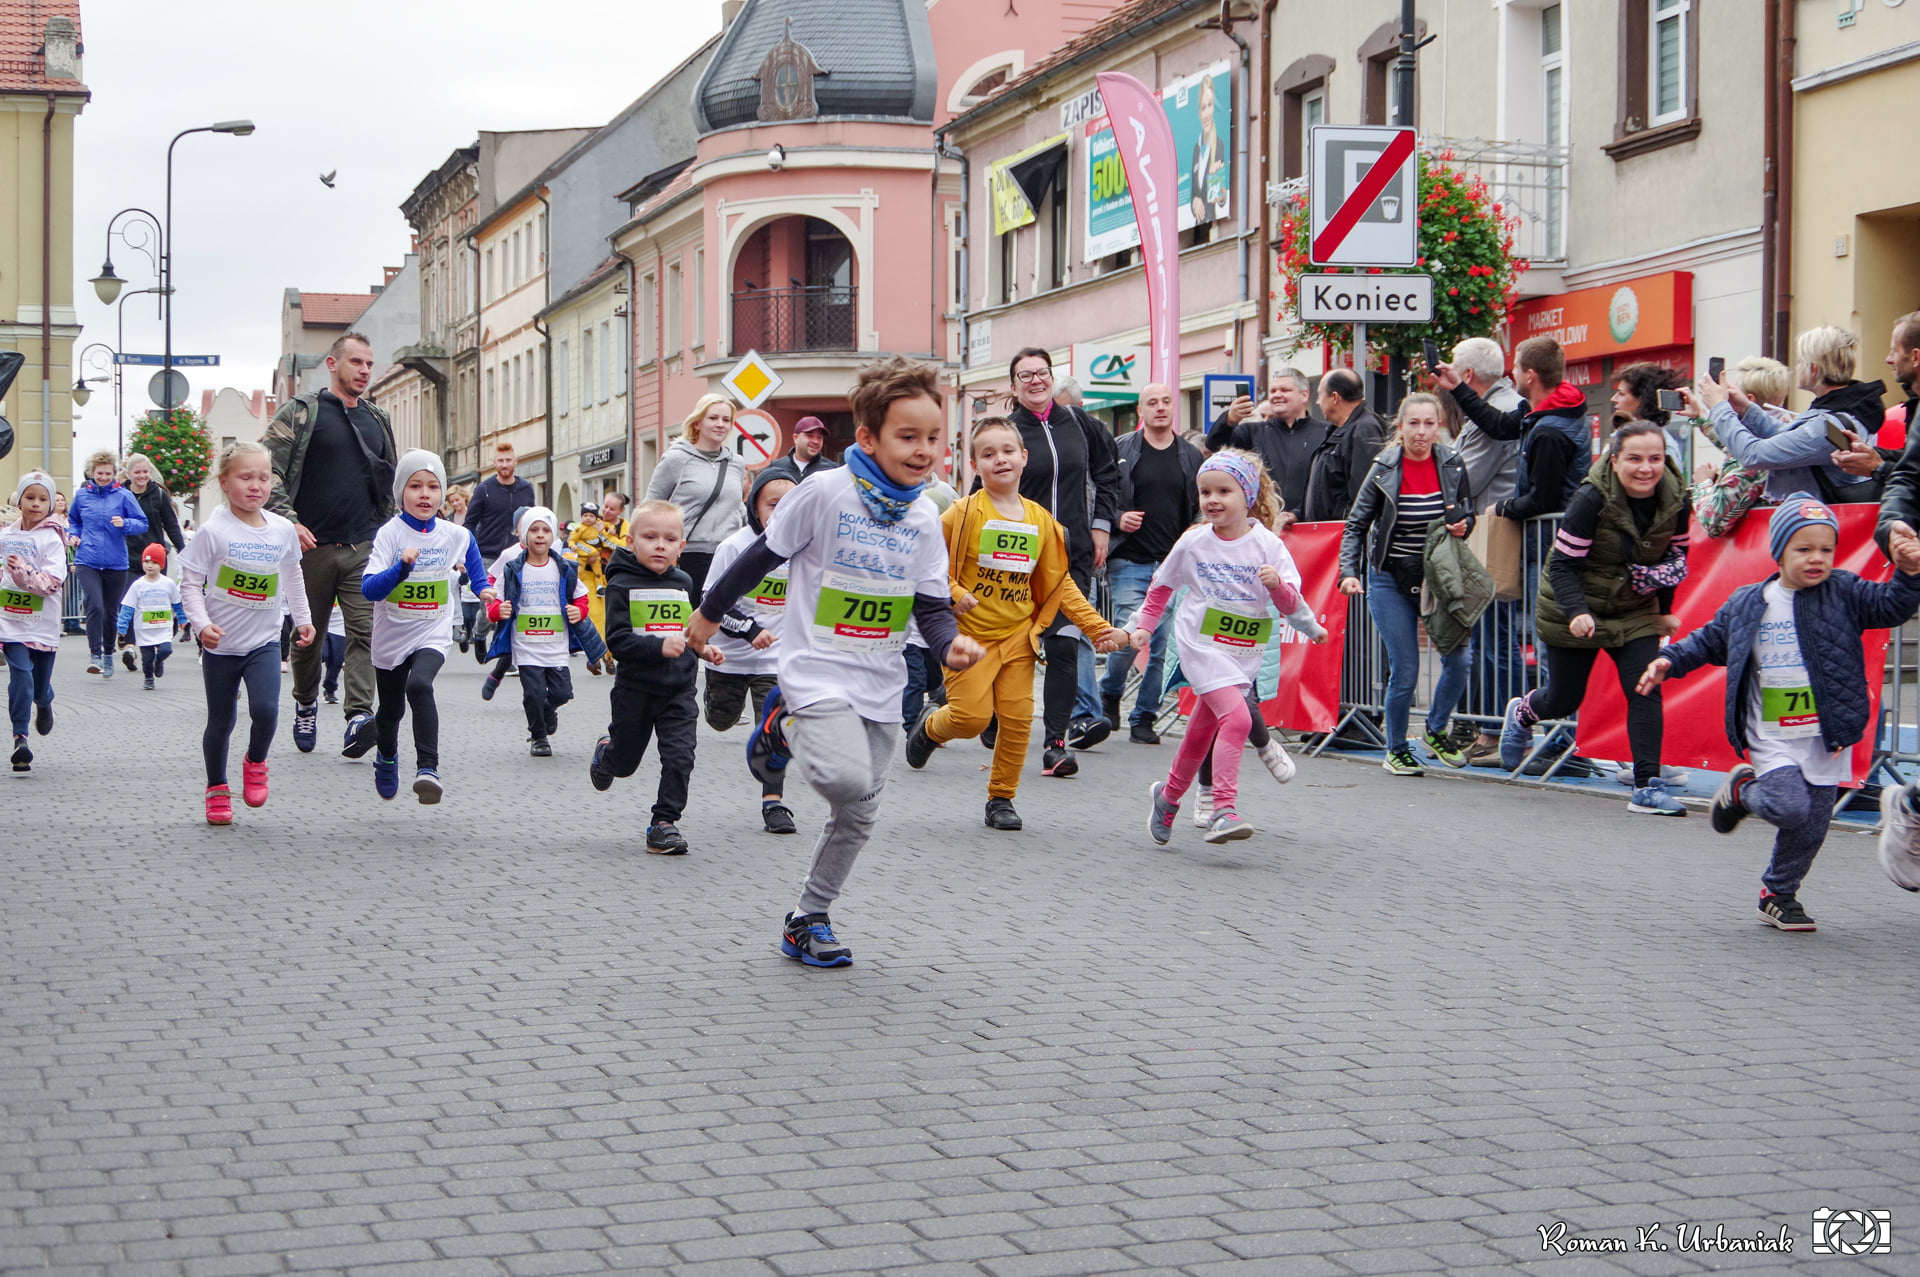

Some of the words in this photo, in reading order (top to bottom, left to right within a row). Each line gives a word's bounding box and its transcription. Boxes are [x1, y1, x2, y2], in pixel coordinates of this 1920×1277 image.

[1314, 285, 1418, 312] Koniec
[1528, 307, 1564, 331] MARKET
[837, 522, 914, 555] Pleszew
[997, 533, 1028, 551] 672
[228, 548, 280, 562] Pleszew
[233, 574, 269, 592] 834
[972, 582, 994, 598] PO
[7, 591, 32, 607] 732
[403, 585, 436, 600] 381
[150, 611, 165, 620] 710
[647, 603, 682, 620] 762
[843, 597, 894, 623] 705
[528, 617, 552, 628] 917
[1218, 616, 1261, 637] 908
